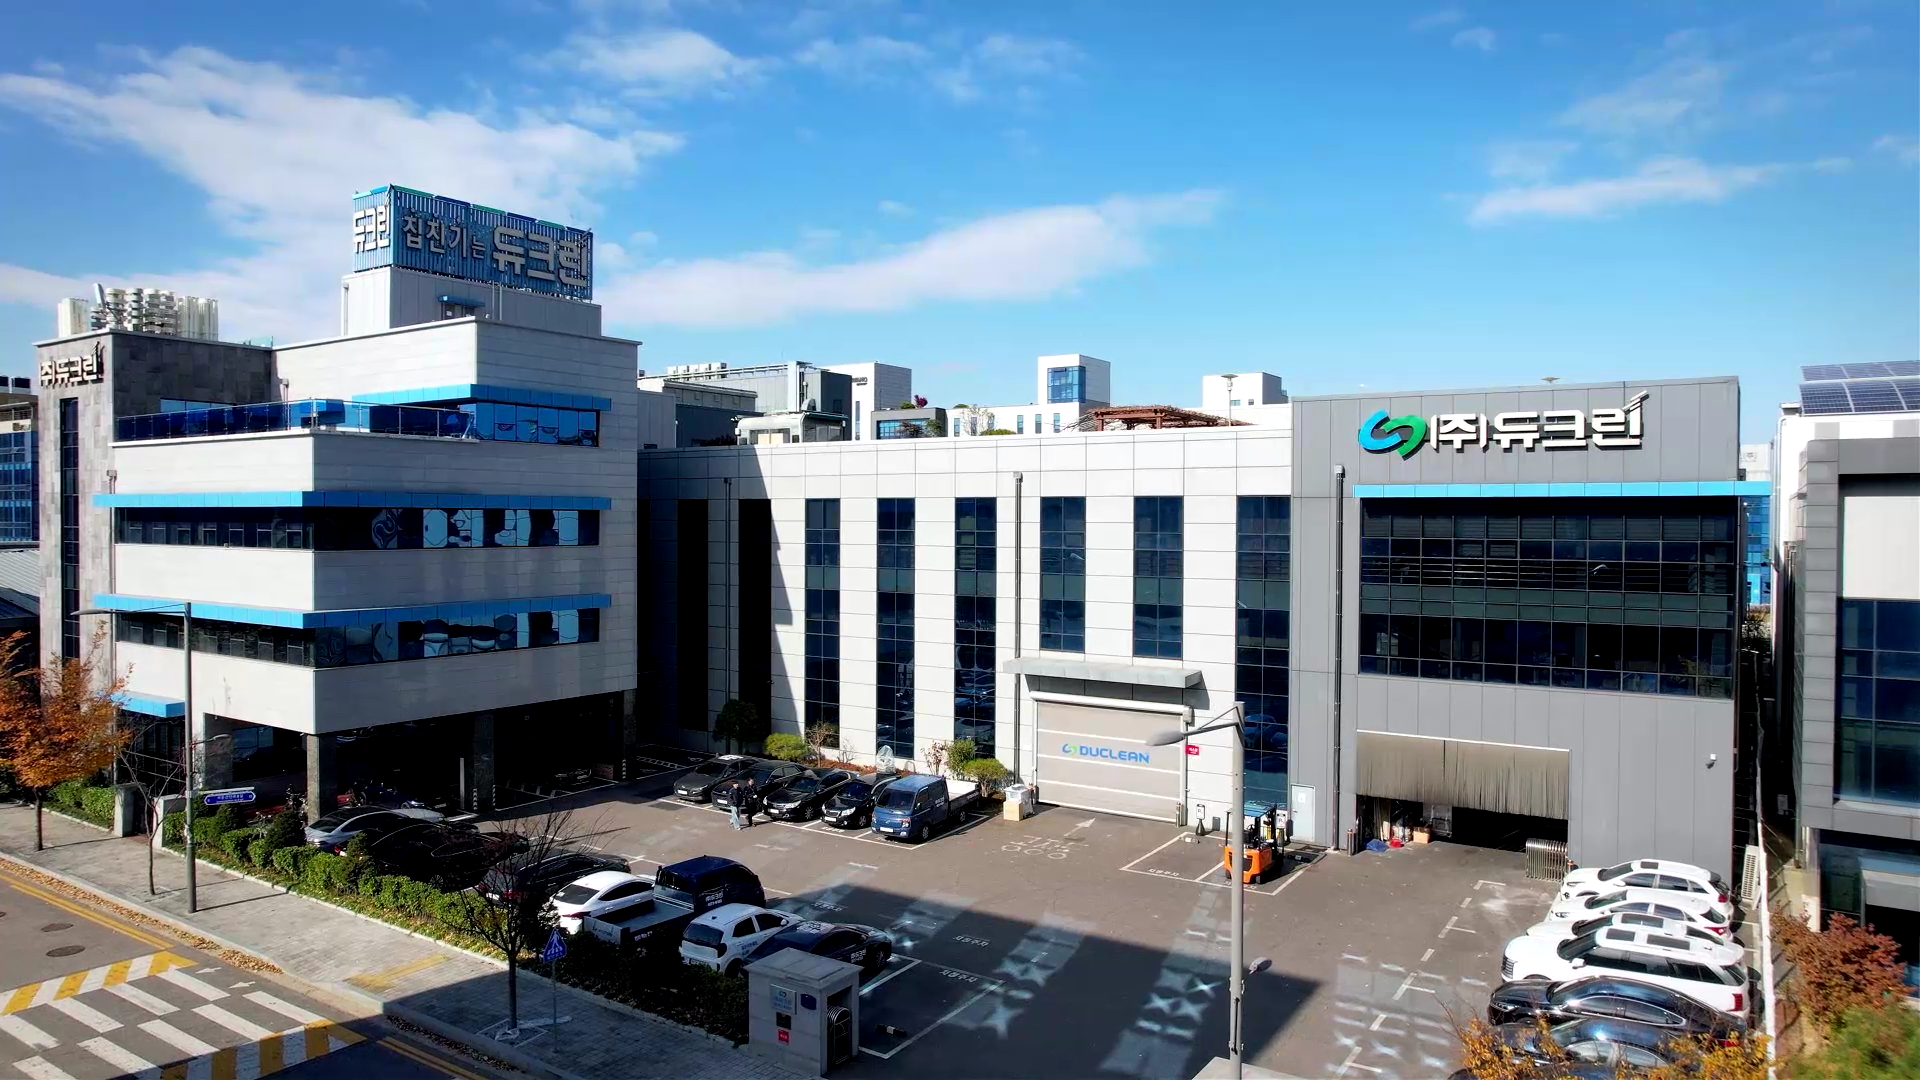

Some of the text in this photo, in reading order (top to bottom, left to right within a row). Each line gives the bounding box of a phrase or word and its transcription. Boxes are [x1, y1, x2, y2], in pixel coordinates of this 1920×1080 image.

[353, 195, 391, 253] 듀크린
[492, 226, 591, 287] 듀크린
[1430, 390, 1648, 450] (주)듀크린
[1079, 745, 1151, 764] DUCLEAN
